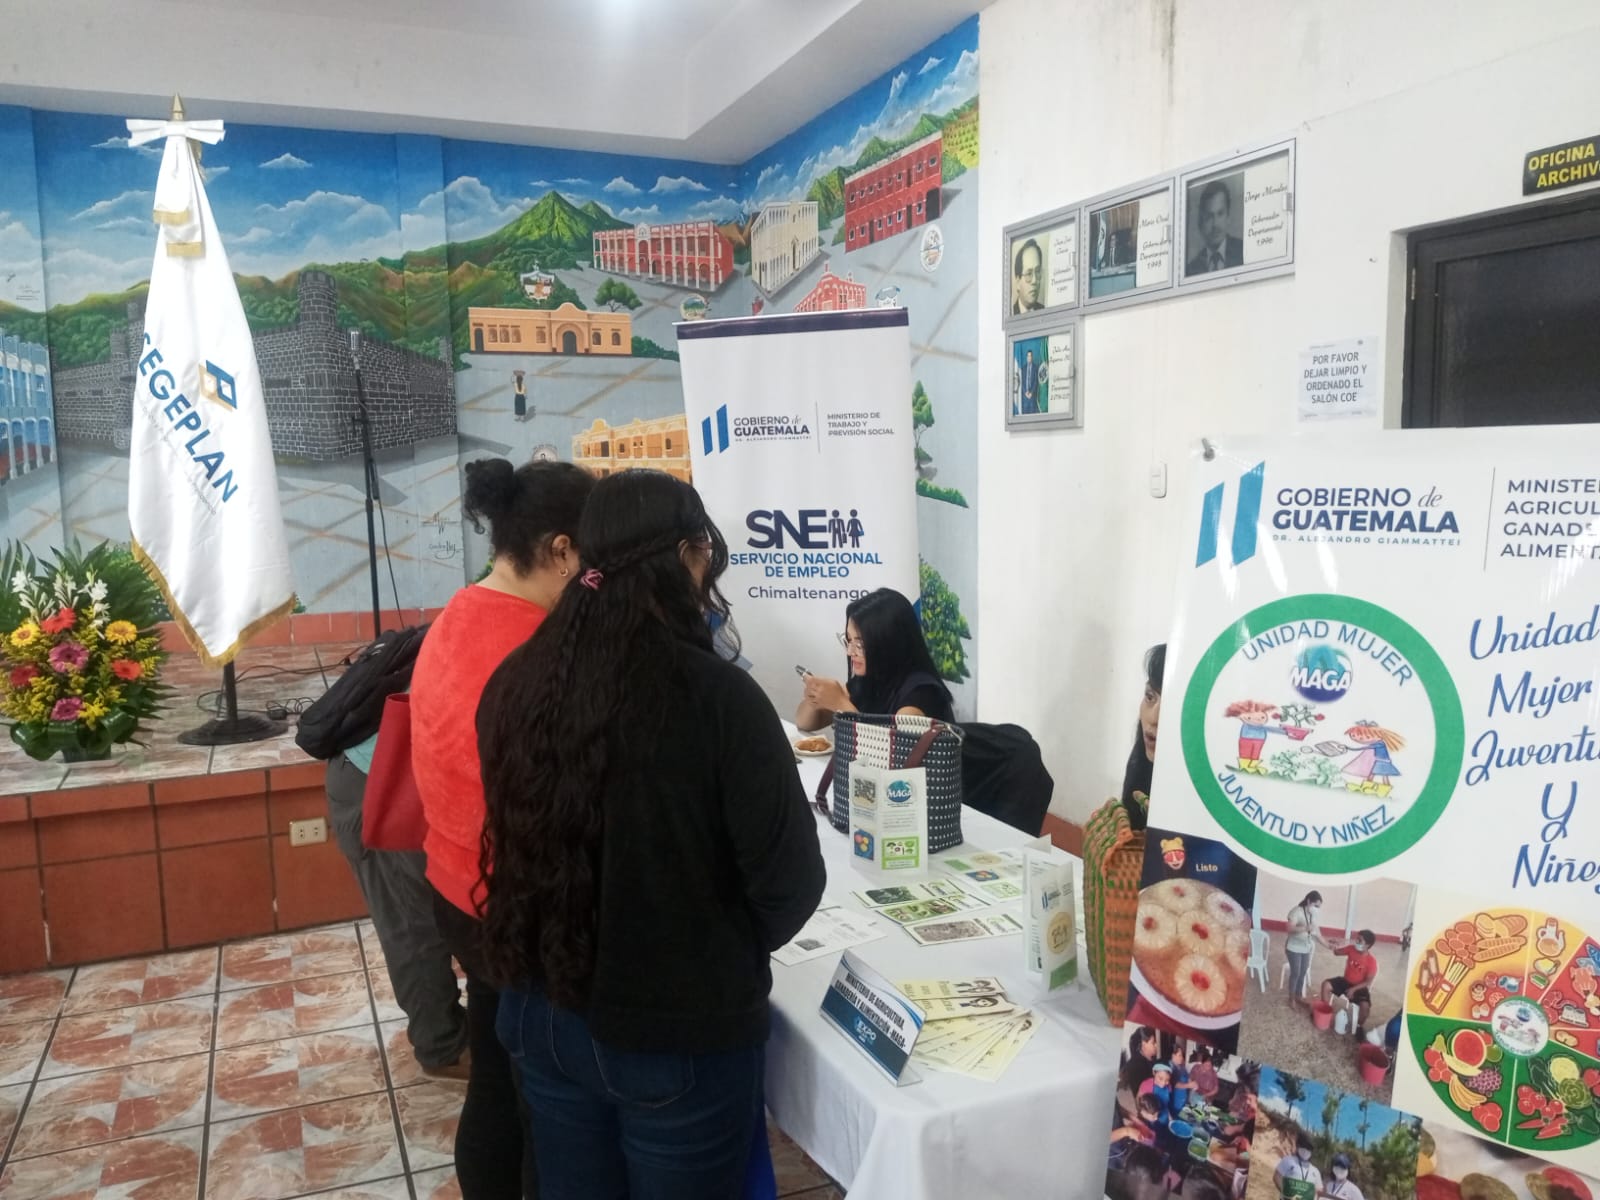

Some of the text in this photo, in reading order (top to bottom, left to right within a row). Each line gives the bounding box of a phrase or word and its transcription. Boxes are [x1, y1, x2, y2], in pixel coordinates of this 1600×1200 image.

[1528, 143, 1595, 171] OFICINA
[1536, 160, 1600, 188] ARCHIV
[1312, 352, 1359, 365] POR FAVOR
[1304, 364, 1367, 379] DEJAR LIMPIO Y
[1306, 378, 1363, 391] ORDENADO EL
[1312, 391, 1357, 404] SALÓN COE
[734, 416, 789, 426] GOBIERNO
[827, 413, 868, 421] MINISTERIO
[734, 424, 811, 437] GUATEMALA
[828, 421, 861, 429] TRABAJO
[1508, 479, 1600, 493] MINISTE
[1277, 486, 1442, 508] GOBIERNO de
[1504, 501, 1600, 515] AGRICUL
[1272, 509, 1460, 534] GUATEMALA
[746, 509, 829, 549] SNE
[1272, 534, 1461, 546] DR. ALEJANDRO GIAMMATTEI
[730, 552, 883, 565] SERVICIO NACIONAL
[765, 566, 849, 578] DE EMPLEO
[1469, 604, 1600, 660] Unidad
[1242, 620, 1413, 687] UNIDAD MUJER
[1289, 667, 1352, 691] MAGA
[1488, 671, 1593, 719] Mujer
[887, 787, 912, 798] MAGA
[1217, 772, 1396, 844] JUVENTUD Y NIÑEZ
[1195, 863, 1218, 872] Listo
[845, 972, 871, 999] MINISTERIO
[868, 989, 877, 1001] DE
[835, 979, 858, 1006] GANADERÍA
[859, 1002, 891, 1033] ALIMENTACIÓN
